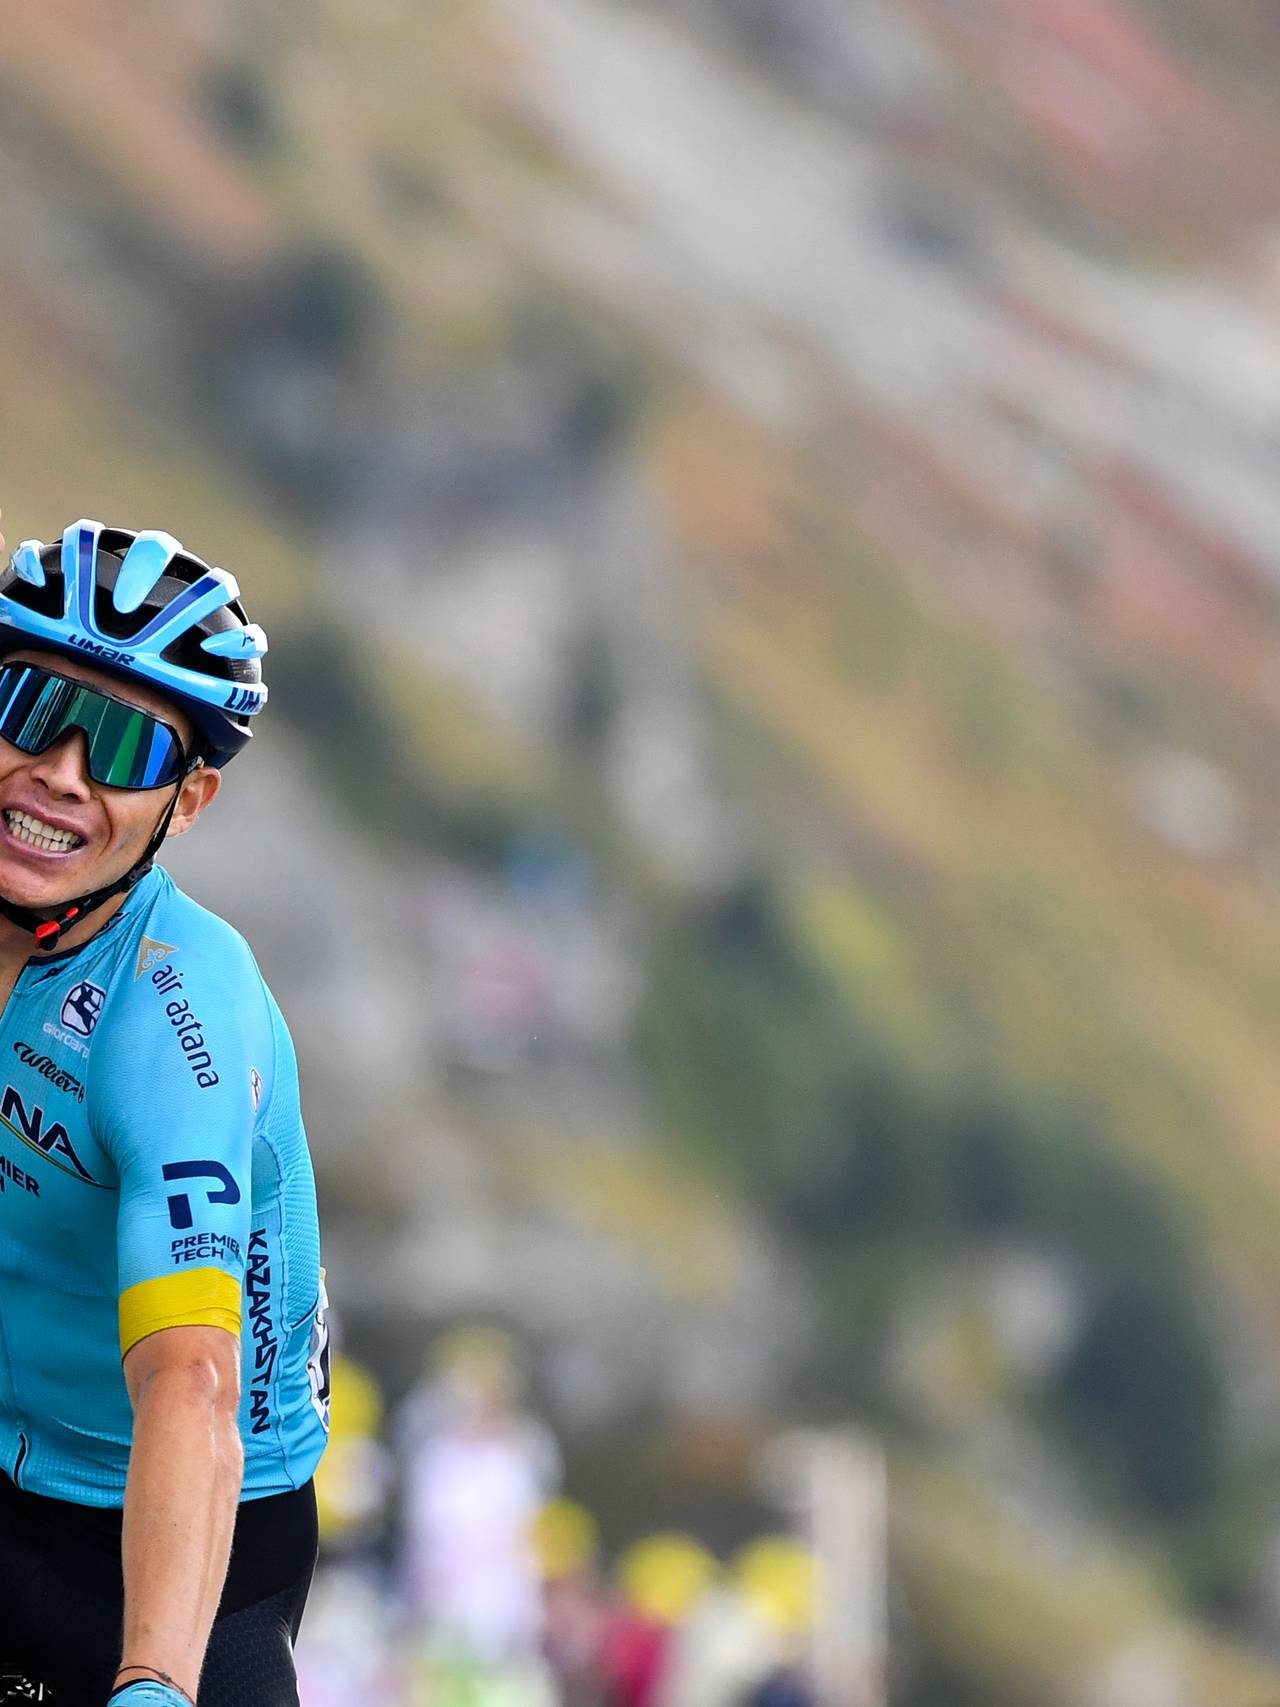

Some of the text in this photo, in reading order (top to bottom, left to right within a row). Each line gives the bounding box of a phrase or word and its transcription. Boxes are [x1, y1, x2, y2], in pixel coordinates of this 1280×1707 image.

[67, 633, 135, 665] LIMAR
[223, 686, 261, 713] LIM
[151, 964, 219, 1089] air astana
[13, 1041, 85, 1103] Wilier
[171, 1246, 224, 1264] TECH
[245, 1228, 277, 1434] KAZAKHSTAN
